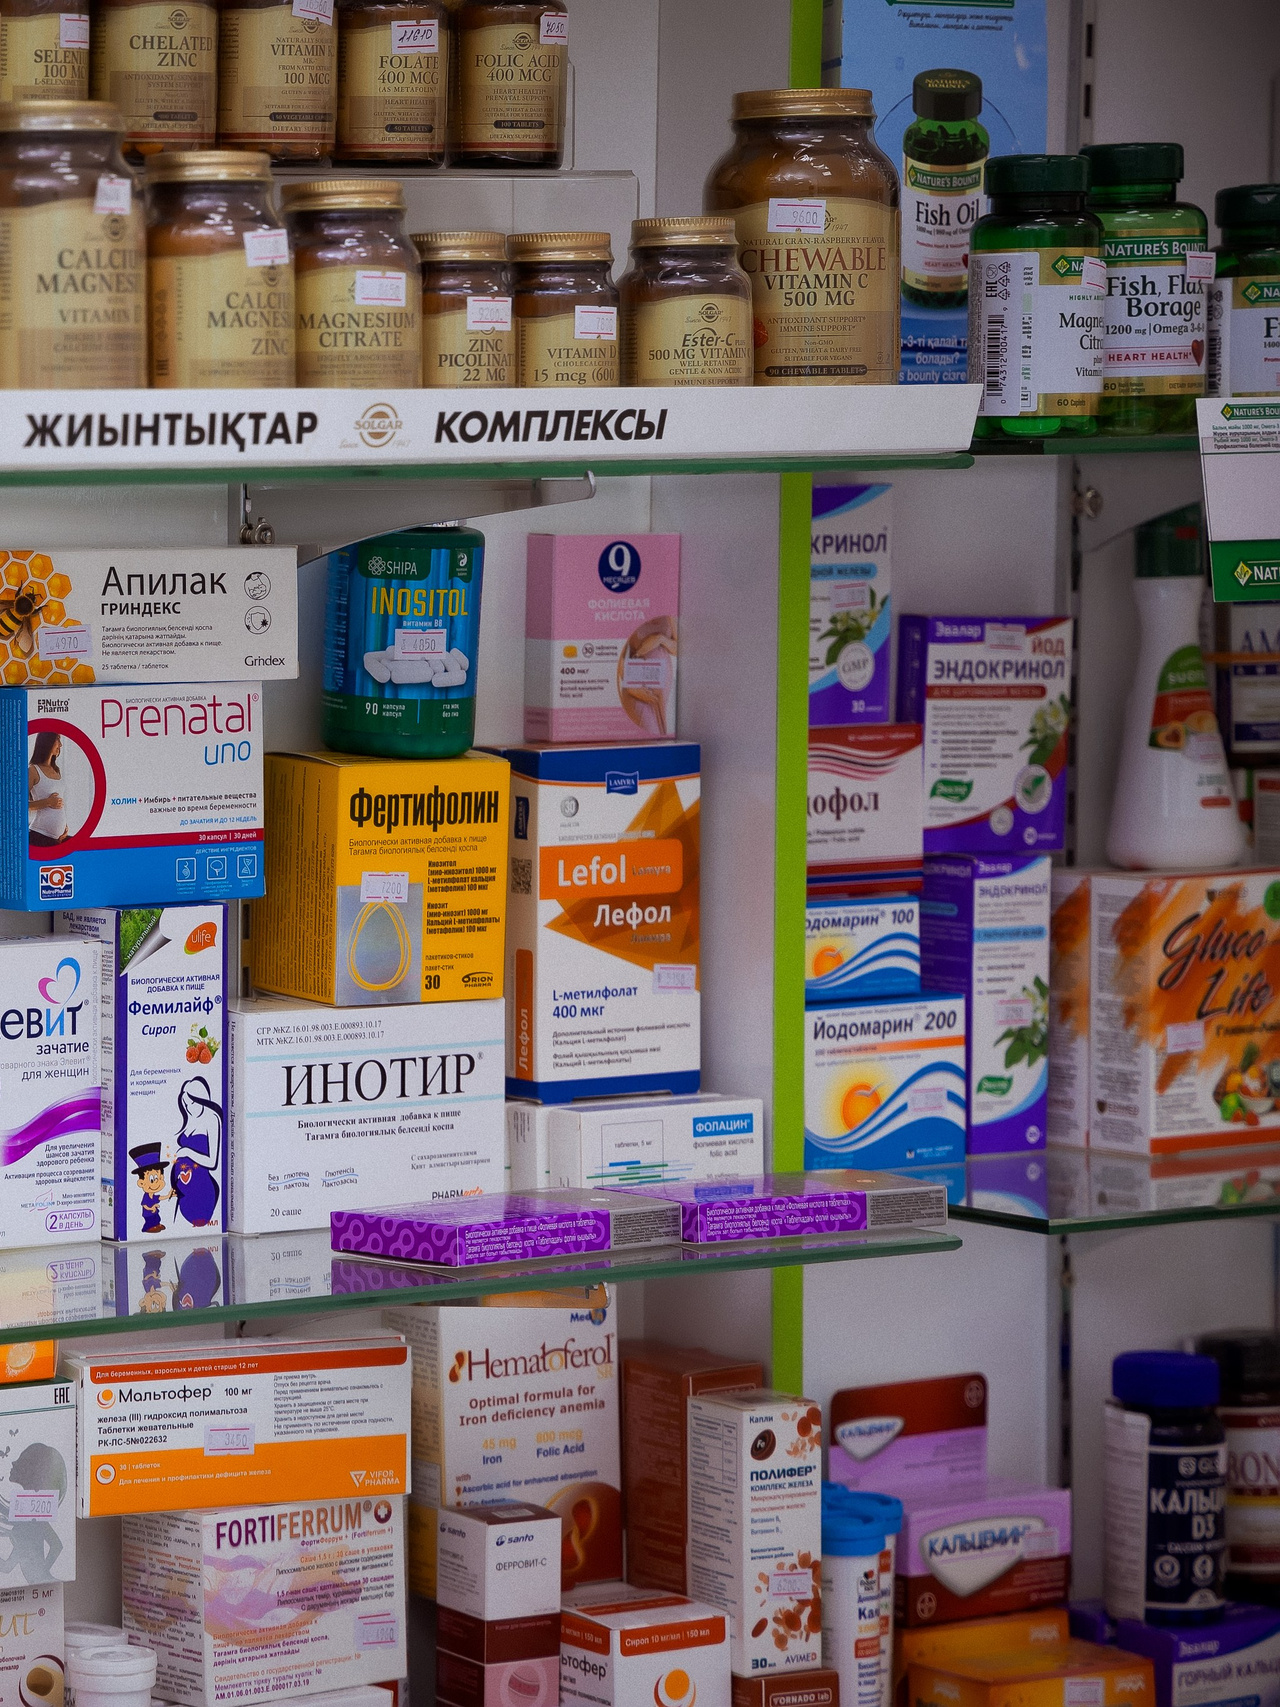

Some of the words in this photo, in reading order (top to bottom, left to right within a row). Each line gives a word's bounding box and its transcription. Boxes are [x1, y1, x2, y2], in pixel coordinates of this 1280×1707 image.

[129, 35, 213, 52] CHELATED
[271, 43, 323, 57] VITAMIN
[157, 52, 197, 68] ZINC
[379, 55, 439, 70] FOLATE
[475, 54, 524, 70] FOLIC
[527, 55, 560, 69] ACID
[43, 65, 67, 78] 100
[284, 73, 304, 85] 100
[307, 73, 330, 85] MCG
[378, 71, 404, 84] 400
[407, 70, 439, 84] MCG
[486, 68, 514, 82] 400
[518, 68, 552, 82] MCG
[792, 210, 818, 224] 9600
[915, 201, 955, 226] Fish
[959, 198, 979, 223] Oil
[1104, 241, 1169, 256] NATURE'S
[741, 247, 887, 274] CHEWABLE
[765, 274, 852, 290] VITAMIN
[858, 273, 868, 288] C
[1106, 275, 1161, 297] Fish,
[1169, 275, 1203, 295] Flax
[783, 291, 817, 307] 500
[825, 291, 855, 306] MG
[1126, 298, 1201, 322] Borage
[299, 312, 416, 330] MAGNESIUM
[1105, 324, 1132, 336] 1200
[1135, 327, 1146, 336] mg
[1154, 324, 1189, 335] Omega
[319, 331, 402, 348] CITRATE
[469, 339, 503, 353] ZINC
[681, 333, 734, 348] Ester-C
[928, 336, 957, 349] қалай
[546, 347, 605, 360] VITAMIN
[648, 349, 671, 361] 500
[673, 349, 696, 360] MG
[699, 348, 747, 360] VITAMIN
[915, 352, 959, 365] болады?
[1108, 353, 1155, 362] HEART
[462, 369, 481, 382] 22
[484, 369, 506, 382] MG
[781, 367, 827, 376] CHEWABLE
[1057, 398, 1069, 407] 60
[23, 411, 319, 452] ЖИЫНТЫҚТАР
[434, 409, 668, 443] КОМПЛЕКСЫ
[386, 561, 417, 575] SHIPA
[101, 567, 227, 596] Апилак
[101, 601, 181, 617] ГРИНДЕКС
[372, 588, 468, 617] INOSITOL
[588, 599, 650, 610] ФОЛИЕВАЯ
[403, 620, 431, 628] витамин
[594, 610, 646, 622] КИСЛОТА
[412, 638, 436, 653] 4850
[244, 655, 285, 667] Grindex
[934, 659, 1066, 682] ЭНДОКРИНОЛ
[101, 694, 252, 739] Prenatal
[204, 740, 251, 766] uno
[111, 797, 137, 805] ХОЛИН
[349, 785, 499, 835] Фертифолин
[41, 869, 72, 887] NQS
[558, 856, 626, 889] Lefol
[594, 903, 672, 930] Лефол
[891, 909, 914, 925] 100
[1158, 913, 1268, 991] Gluco
[131, 975, 190, 985] БИОЛОГИЧЕСКИ
[192, 973, 220, 983] АКТИВНАЯ
[424, 974, 441, 991] 30
[462, 972, 494, 983] ORION
[552, 986, 638, 1003] L-метилфолат
[1197, 970, 1275, 1020] Life
[128, 996, 214, 1018] Фемилайф
[552, 1004, 577, 1020] 400
[580, 1005, 605, 1020] мкг
[141, 1024, 177, 1037] Сироп
[813, 1016, 914, 1042] Йодомарин
[925, 1011, 957, 1031] 200
[36, 1041, 90, 1055] зачатие
[21, 1069, 42, 1082] для
[45, 1066, 90, 1081] женщин
[281, 1053, 476, 1107] ИНОТИР
[297, 1114, 355, 1131] Биологически
[357, 1113, 398, 1126] активная
[400, 1111, 432, 1124] добавка
[440, 1110, 462, 1121] пище
[695, 1118, 750, 1133] ФОЛАЦИН
[270, 1207, 280, 1217] 20
[282, 1208, 302, 1217] саше
[468, 1333, 613, 1382] Hematoferol
[119, 1386, 212, 1407] Мальтофер
[224, 1387, 239, 1397] 100
[241, 1388, 253, 1397] мг
[469, 1393, 520, 1412] Optimal
[523, 1387, 573, 1405] formula
[577, 1383, 595, 1398] for
[97, 1415, 127, 1424] железа
[129, 1413, 142, 1422] (III)
[143, 1410, 187, 1422] гидроксид
[189, 1406, 248, 1418] полимальтоза
[459, 1413, 486, 1427] Iron
[491, 1406, 555, 1425] deficiency
[559, 1398, 605, 1414] anemia
[365, 1477, 400, 1487] PHARMA
[370, 1470, 394, 1479] VIFOR
[750, 1466, 813, 1482] ПОЛИФЕР
[30, 1500, 51, 1514] 5200
[215, 1501, 363, 1549] FORTIFERRUM
[1192, 1514, 1215, 1539] D3
[507, 1533, 534, 1546] santo
[496, 1557, 547, 1573] ФЕРРОВИТ-С
[625, 1635, 648, 1648] Сироп
